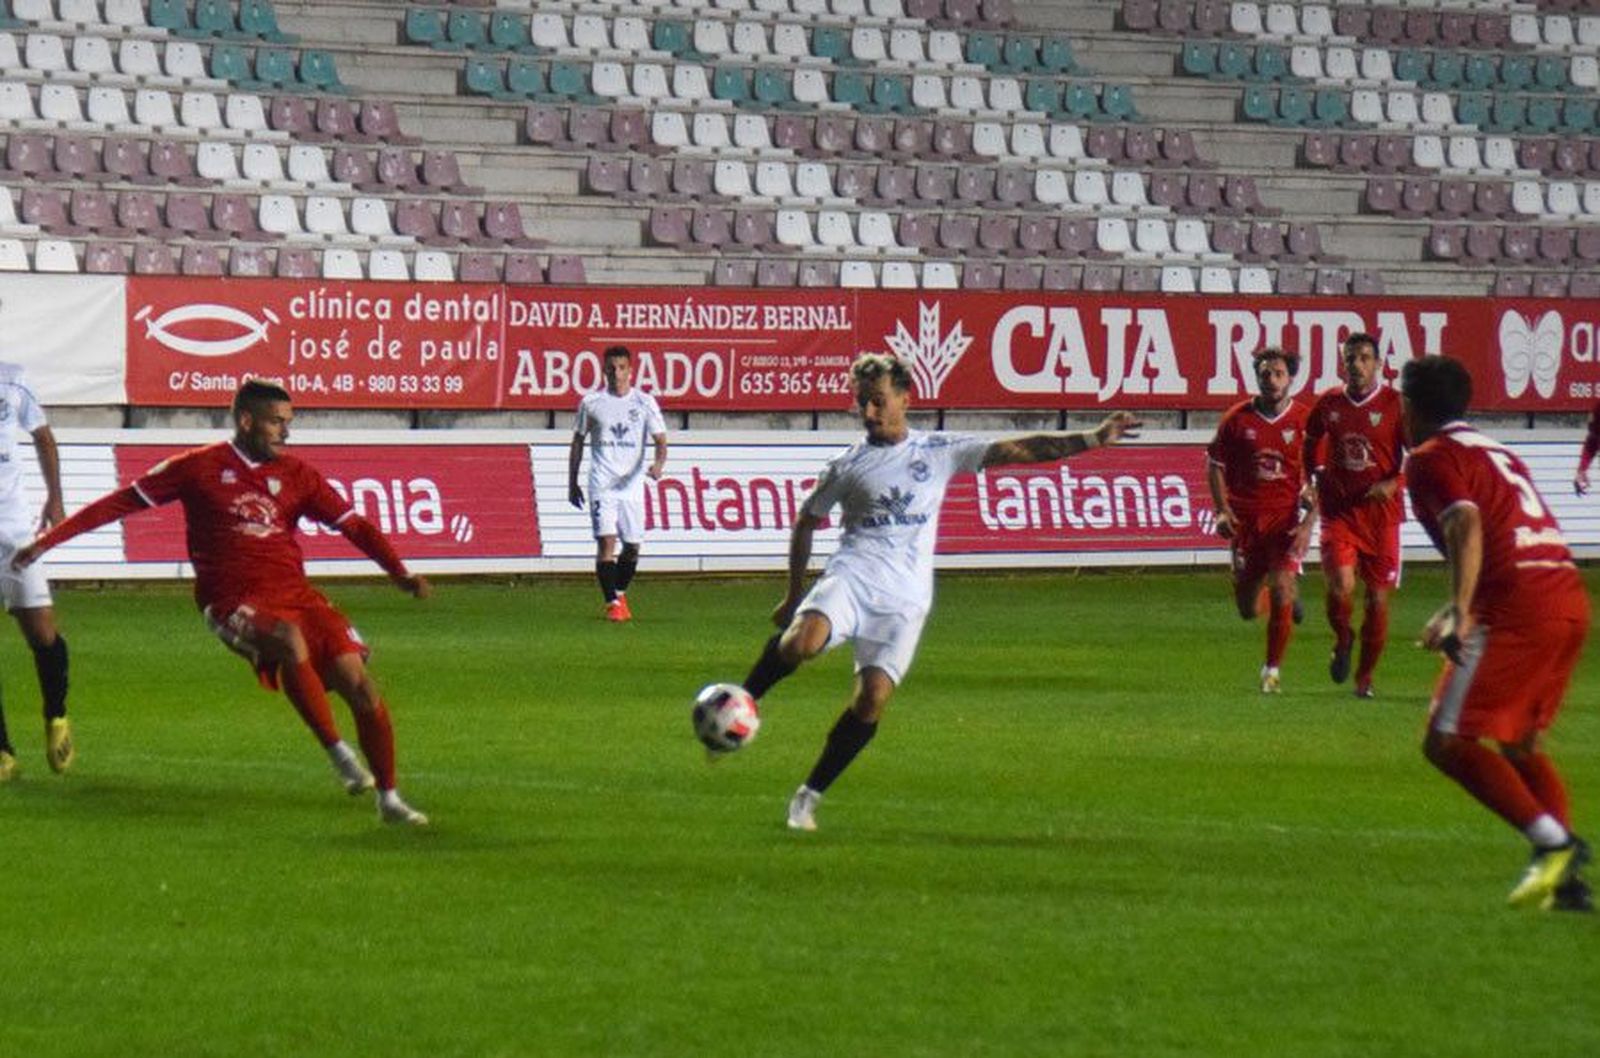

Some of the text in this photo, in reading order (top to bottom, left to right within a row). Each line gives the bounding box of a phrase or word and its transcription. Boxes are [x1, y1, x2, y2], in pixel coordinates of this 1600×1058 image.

[290, 287, 498, 321] clínica dental
[510, 296, 851, 330] DAVID A. HERNÁNDEZ BERNAL
[289, 324, 498, 367] josé de paula
[991, 304, 1188, 401] CAJA
[191, 372, 237, 390] Santa
[332, 374, 354, 391] 4B
[368, 375, 396, 393] 980
[400, 375, 418, 393] 53
[422, 375, 440, 393] 33
[444, 375, 463, 393] 99
[509, 349, 723, 397] ABOADO
[741, 371, 850, 394] 635 365 442
[976, 464, 1192, 530] lantania
